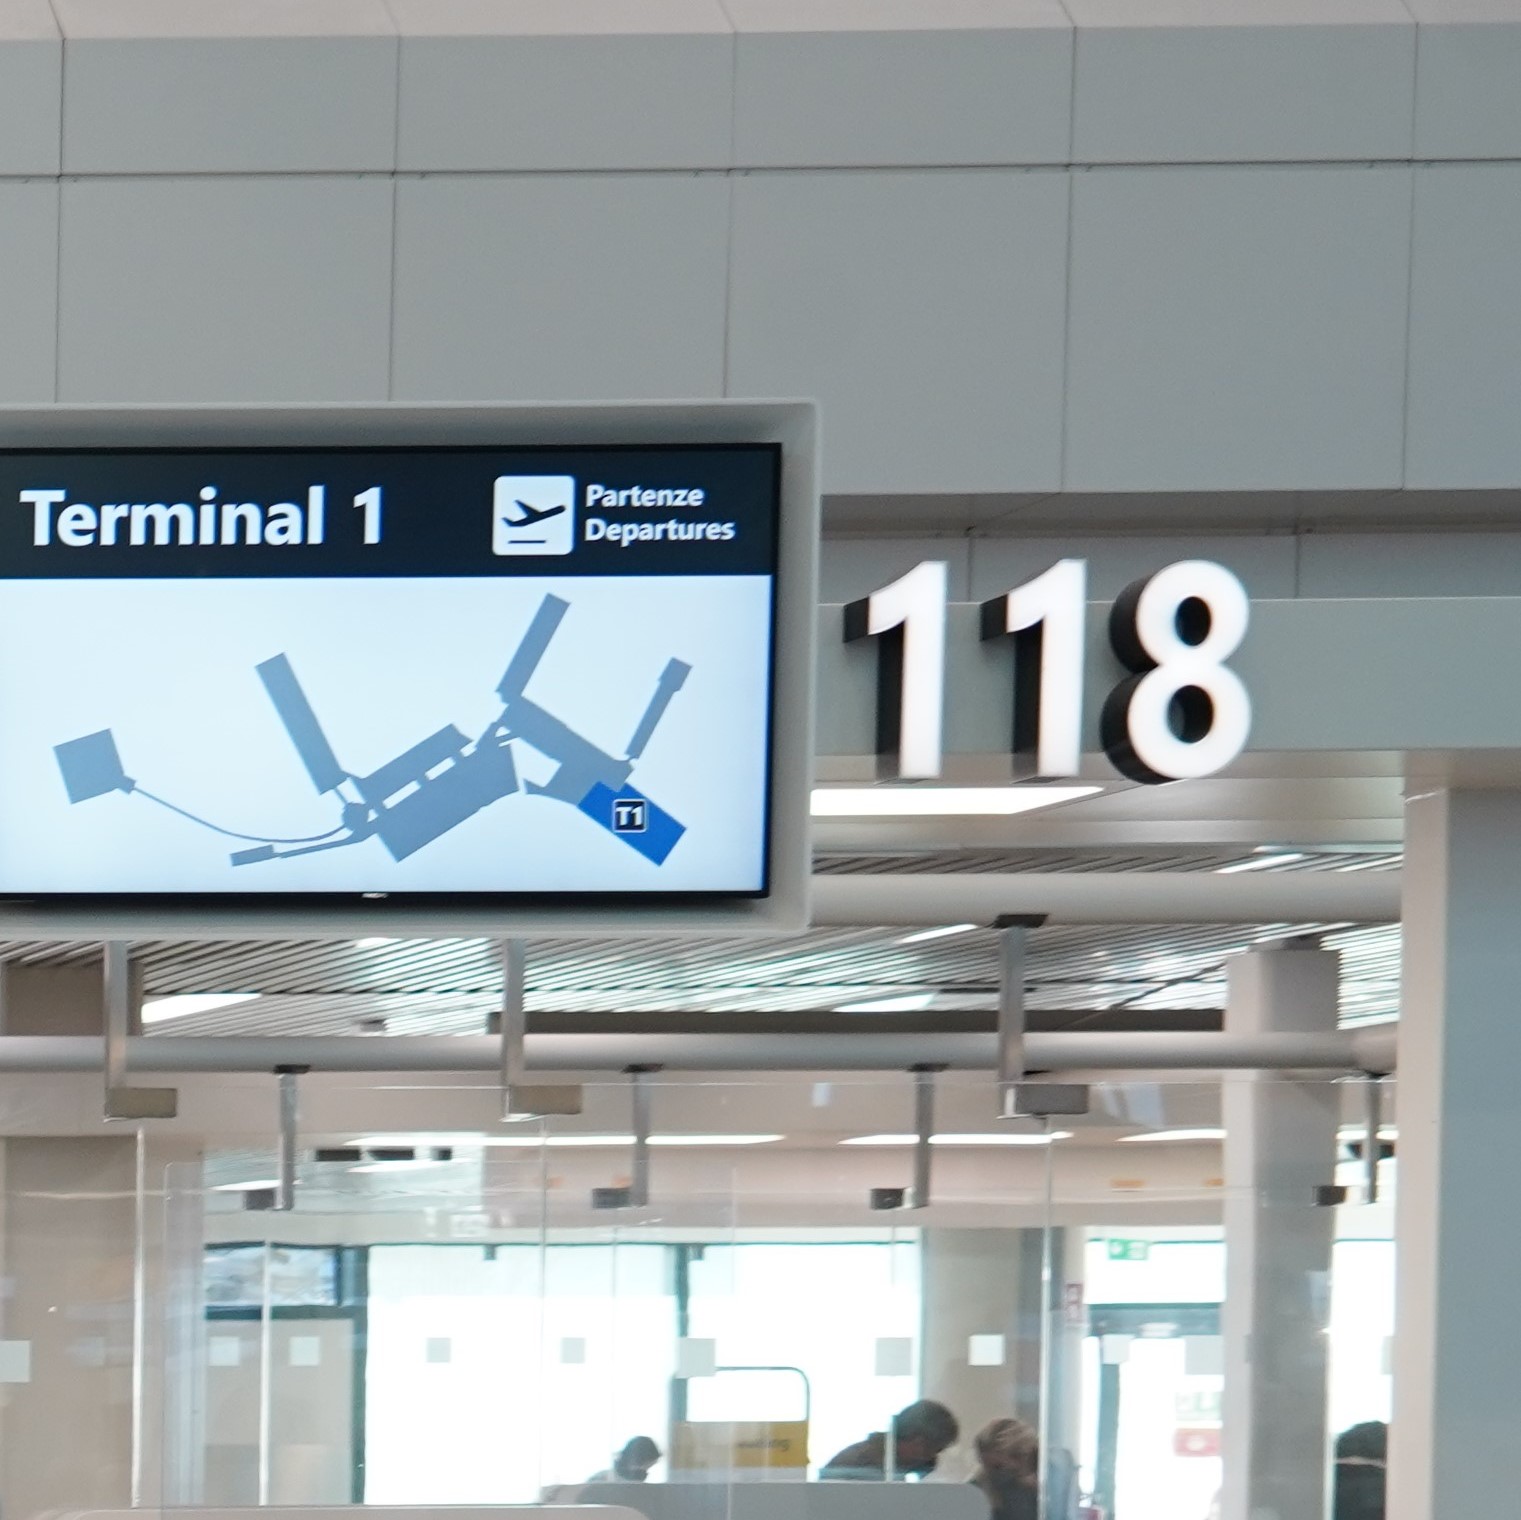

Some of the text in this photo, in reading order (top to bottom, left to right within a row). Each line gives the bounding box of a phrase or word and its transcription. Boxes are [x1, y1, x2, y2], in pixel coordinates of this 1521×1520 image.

[585, 484, 705, 508] Partenze
[19, 485, 382, 547] Terminal 1
[585, 517, 737, 548] Departures
[844, 557, 1252, 784] 118
[615, 805, 643, 827] T1
